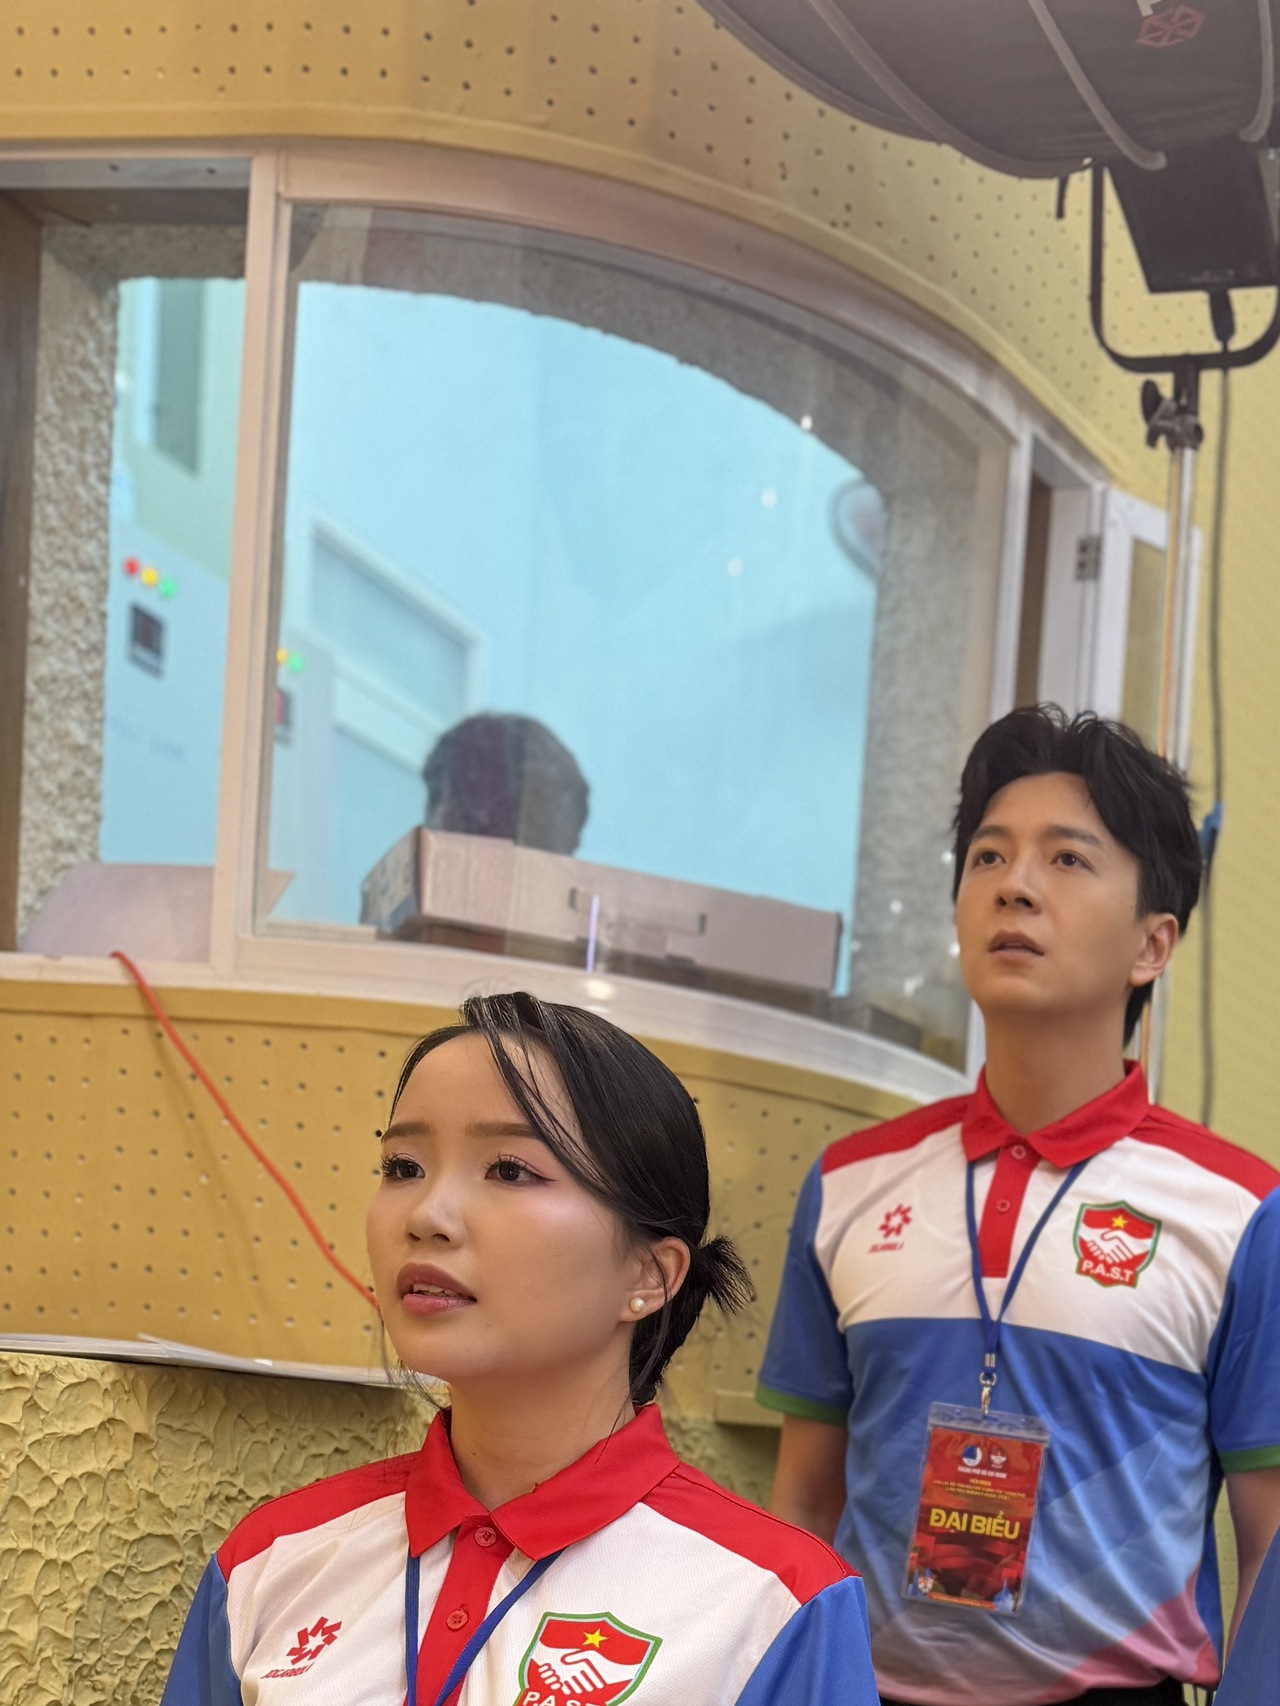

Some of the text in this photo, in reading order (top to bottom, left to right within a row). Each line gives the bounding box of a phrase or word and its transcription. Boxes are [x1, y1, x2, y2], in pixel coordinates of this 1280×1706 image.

[1081, 1260, 1134, 1283] P.A.S.T
[930, 1508, 1020, 1540] ĐẠI BIỂU
